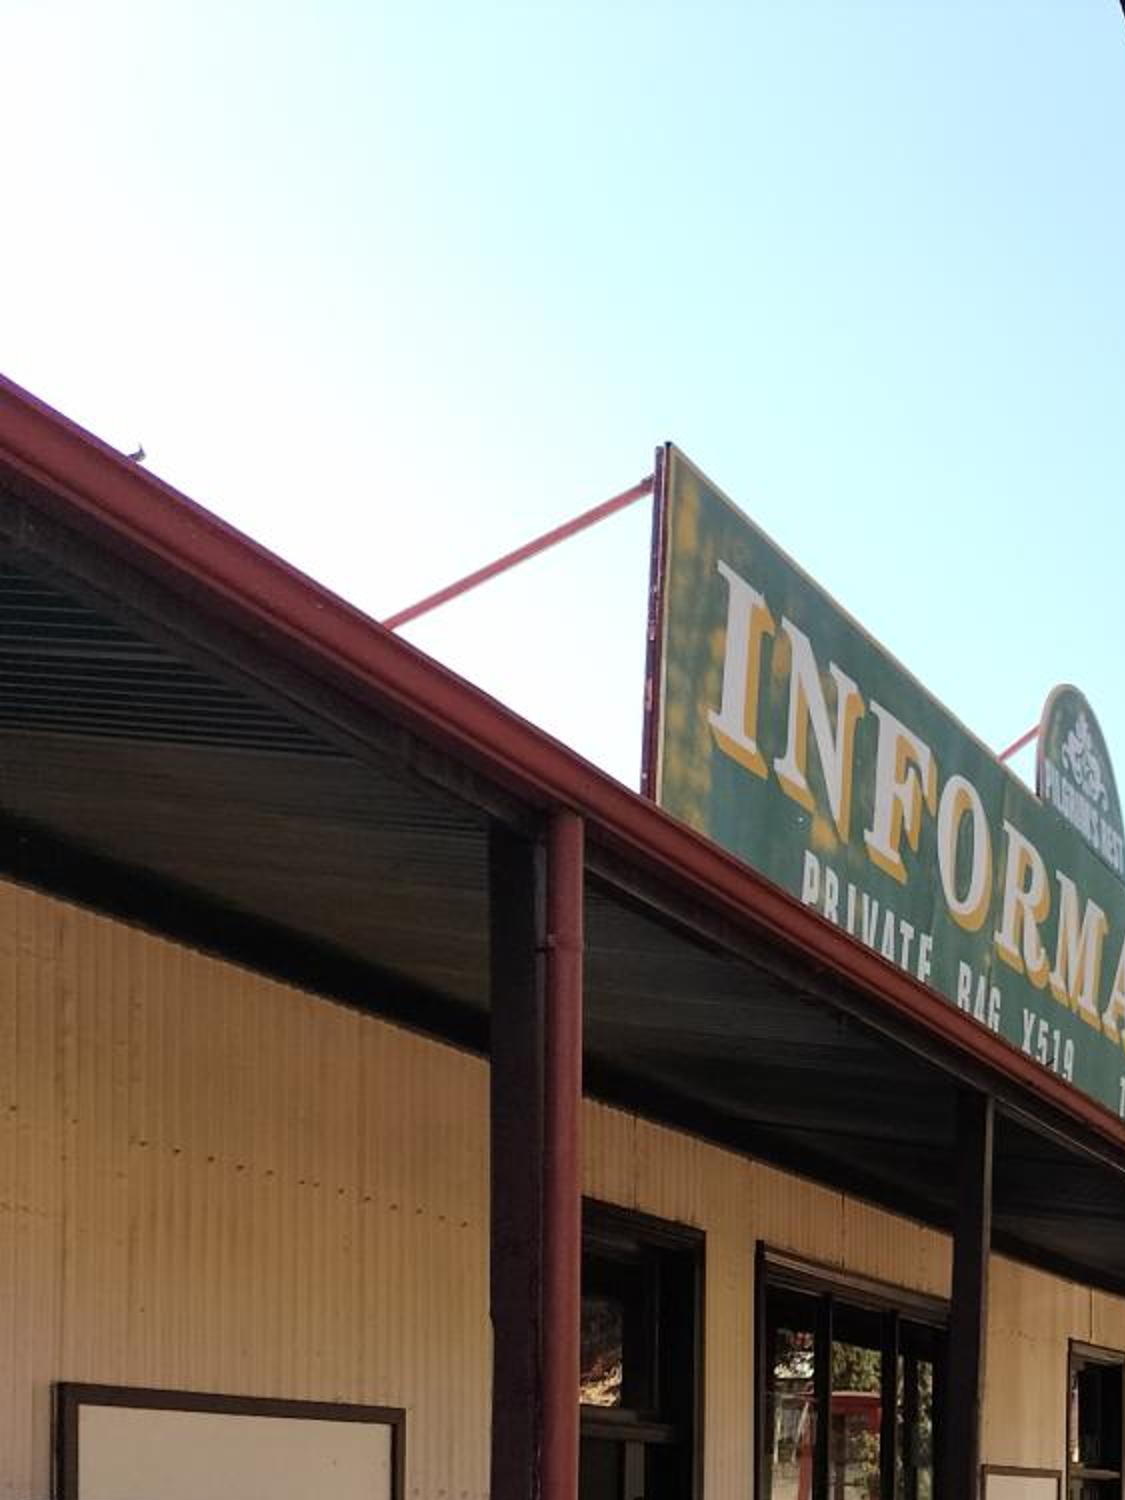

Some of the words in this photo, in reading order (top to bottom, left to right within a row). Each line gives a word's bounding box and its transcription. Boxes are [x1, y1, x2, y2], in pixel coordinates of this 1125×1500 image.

[801, 849, 933, 983] PRIVATE
[957, 960, 1001, 1033] BAG
[1022, 1008, 1075, 1082] X519
